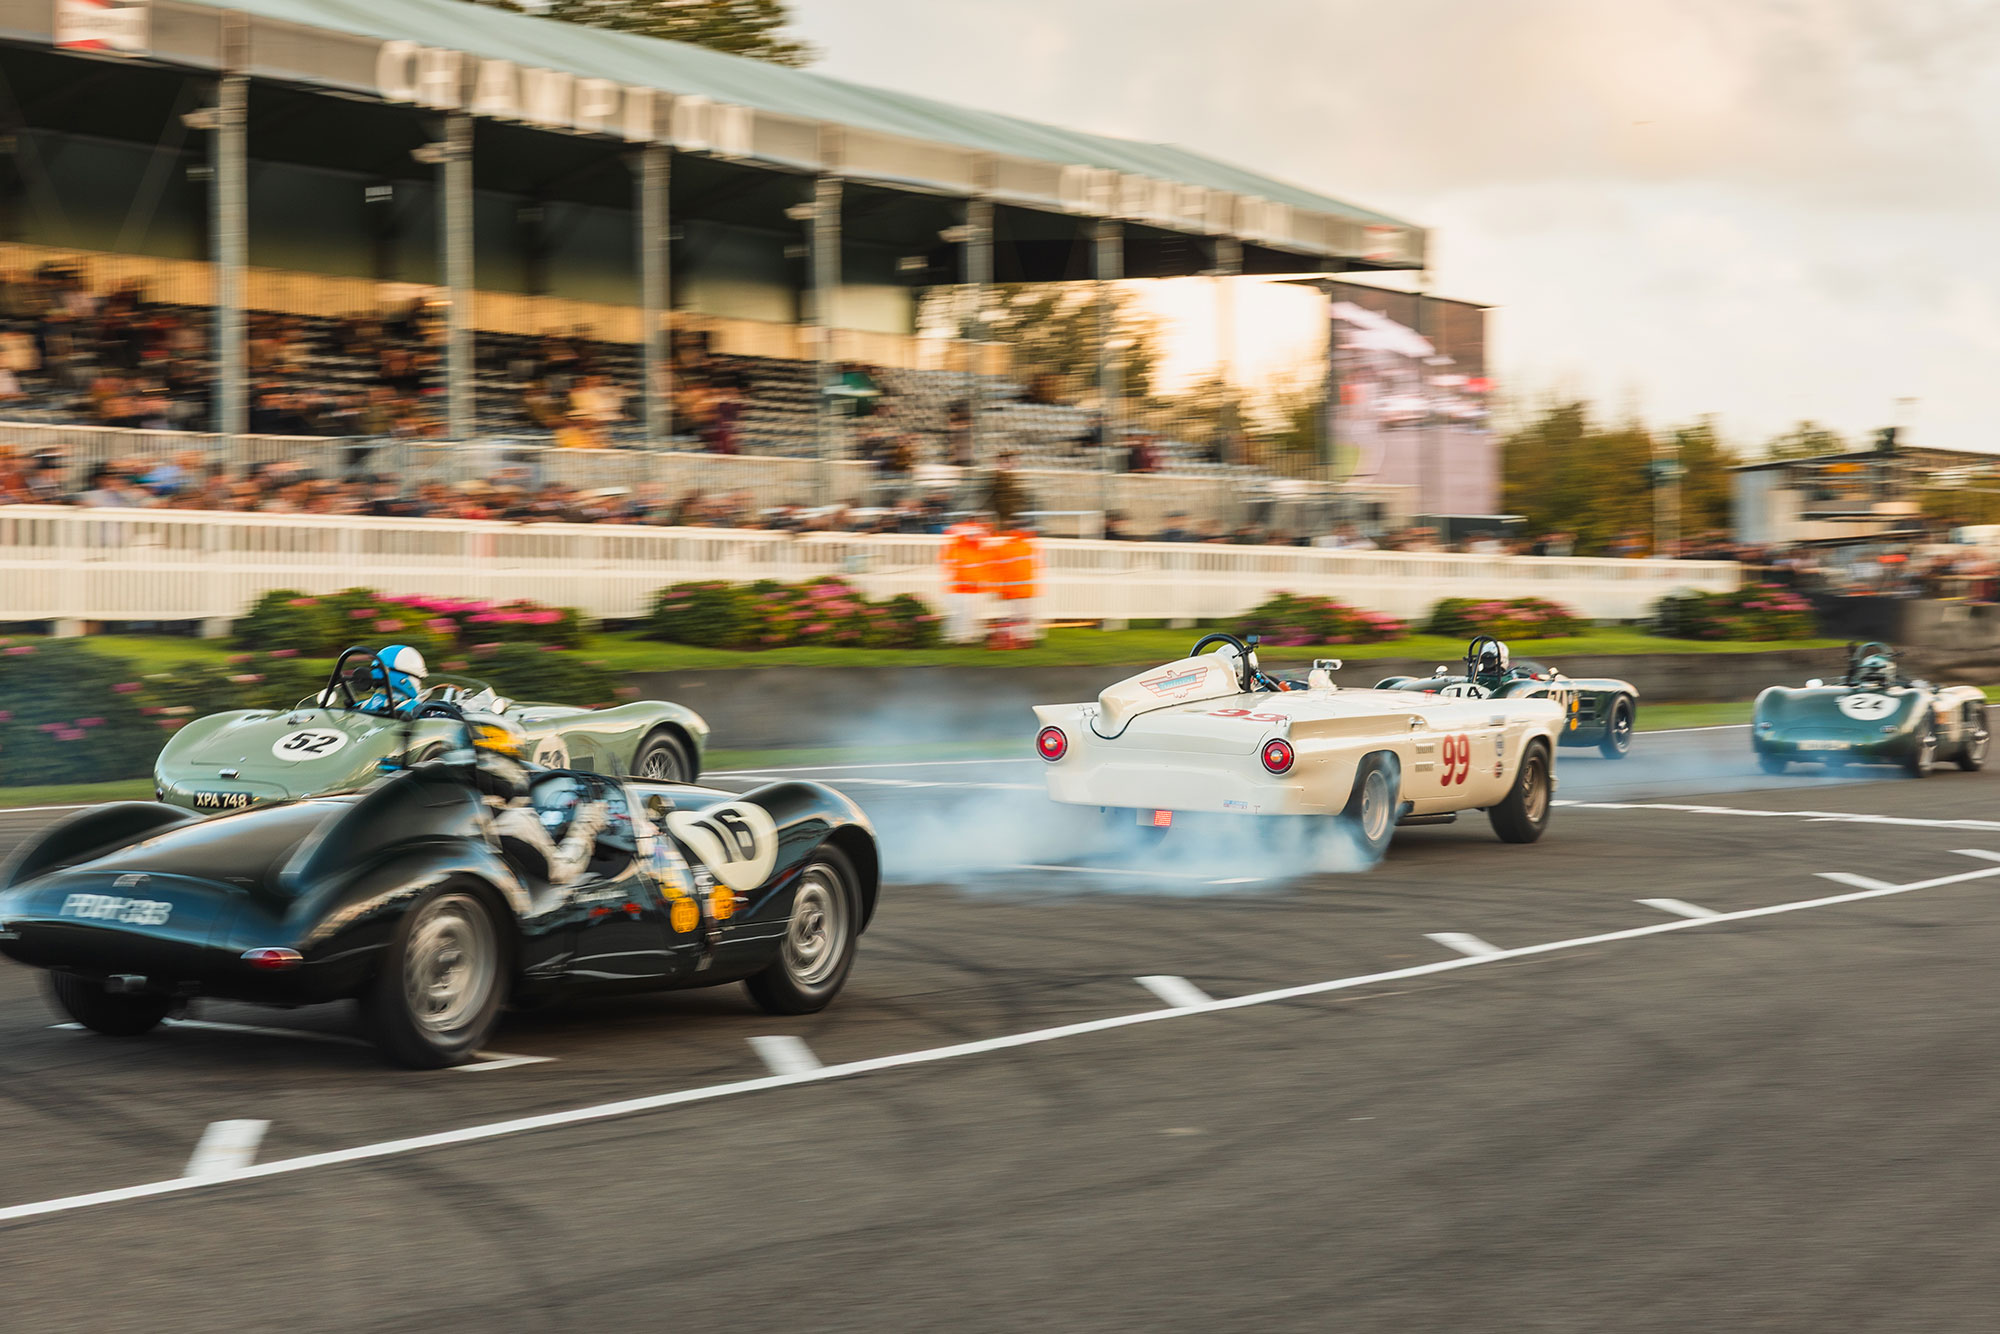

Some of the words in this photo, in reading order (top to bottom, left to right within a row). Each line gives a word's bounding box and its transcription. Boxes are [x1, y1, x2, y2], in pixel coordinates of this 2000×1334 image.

[1208, 708, 1288, 722] 99
[283, 732, 338, 754] 52
[1440, 733, 1470, 787] 99
[196, 792, 220, 808] XPA
[222, 793, 248, 808] 748
[690, 808, 756, 863] 16
